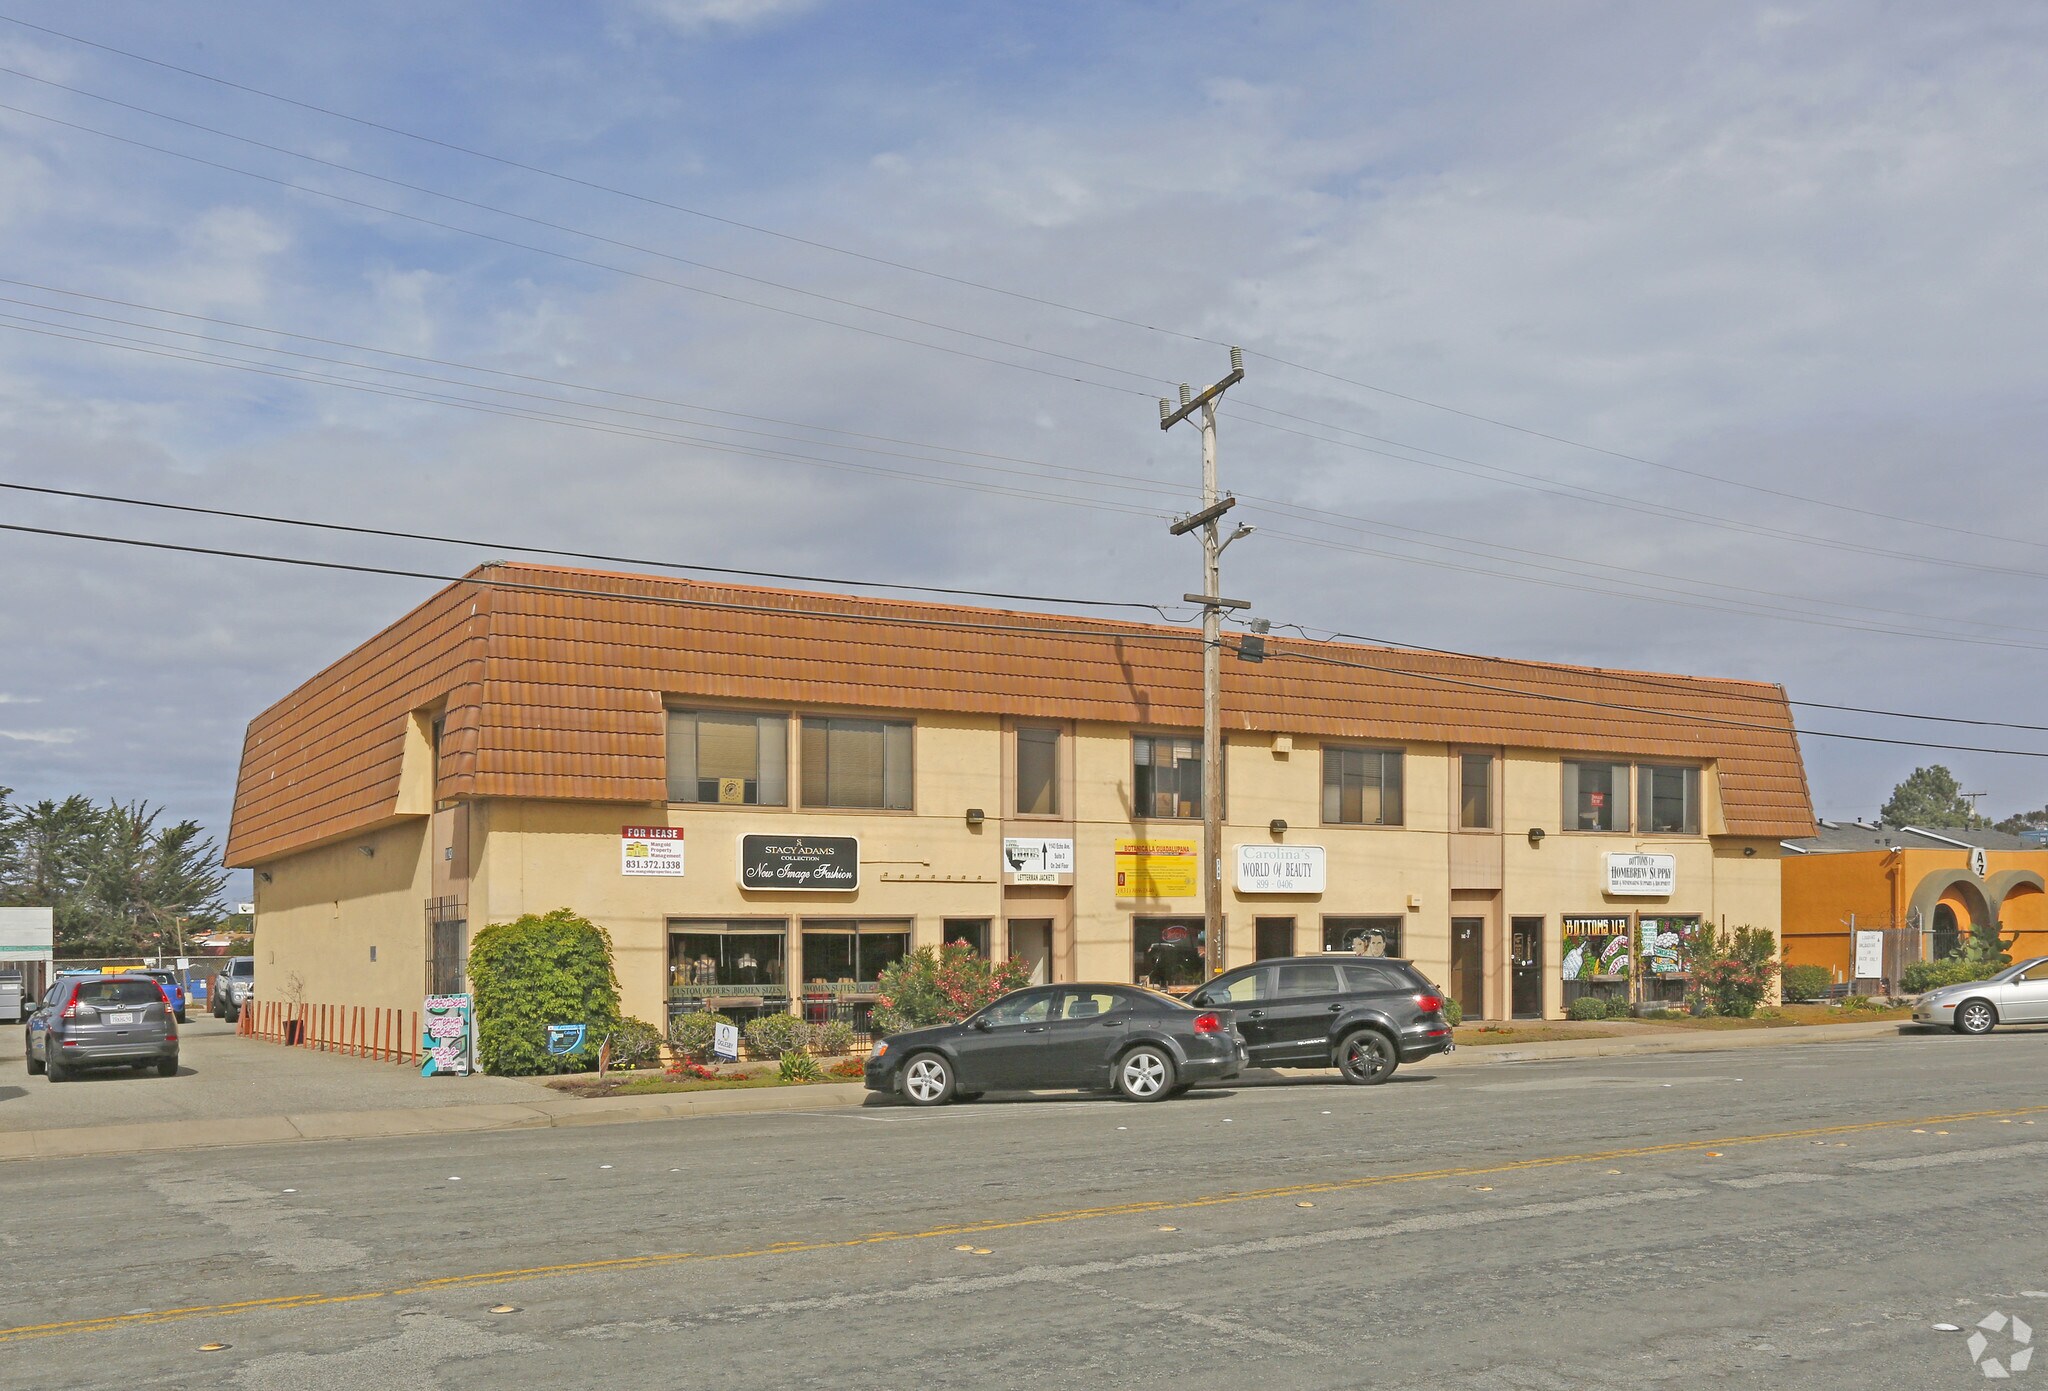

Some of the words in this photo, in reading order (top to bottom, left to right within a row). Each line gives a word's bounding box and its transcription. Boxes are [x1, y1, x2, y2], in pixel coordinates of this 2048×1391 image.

[628, 828, 646, 838] FOR
[650, 829, 678, 839] LEASE
[765, 846, 798, 854] STACY
[798, 846, 834, 856] ADAMS
[1244, 848, 1310, 860] Carolina's
[1628, 856, 1648, 866] BOTTOMS
[1976, 852, 1984, 863] A
[626, 860, 680, 869] 831.372.1338
[1242, 862, 1270, 877] WORLD
[1286, 863, 1312, 877] BEAUTY
[1978, 864, 1984, 876] Z
[746, 862, 774, 878] New
[776, 863, 811, 884] Image
[813, 864, 852, 879] Fashion
[1018, 874, 1038, 882] LETTERMAN
[1039, 874, 1055, 882] JACKETS
[1611, 866, 1648, 879] HOMEBREW
[1650, 867, 1672, 879] SUPPLY
[1256, 880, 1269, 888] 899
[1276, 880, 1293, 889] 0406
[1566, 920, 1610, 936] BOTTOMS
[1611, 920, 1625, 936] UP
[672, 987, 700, 995] CUSTOM
